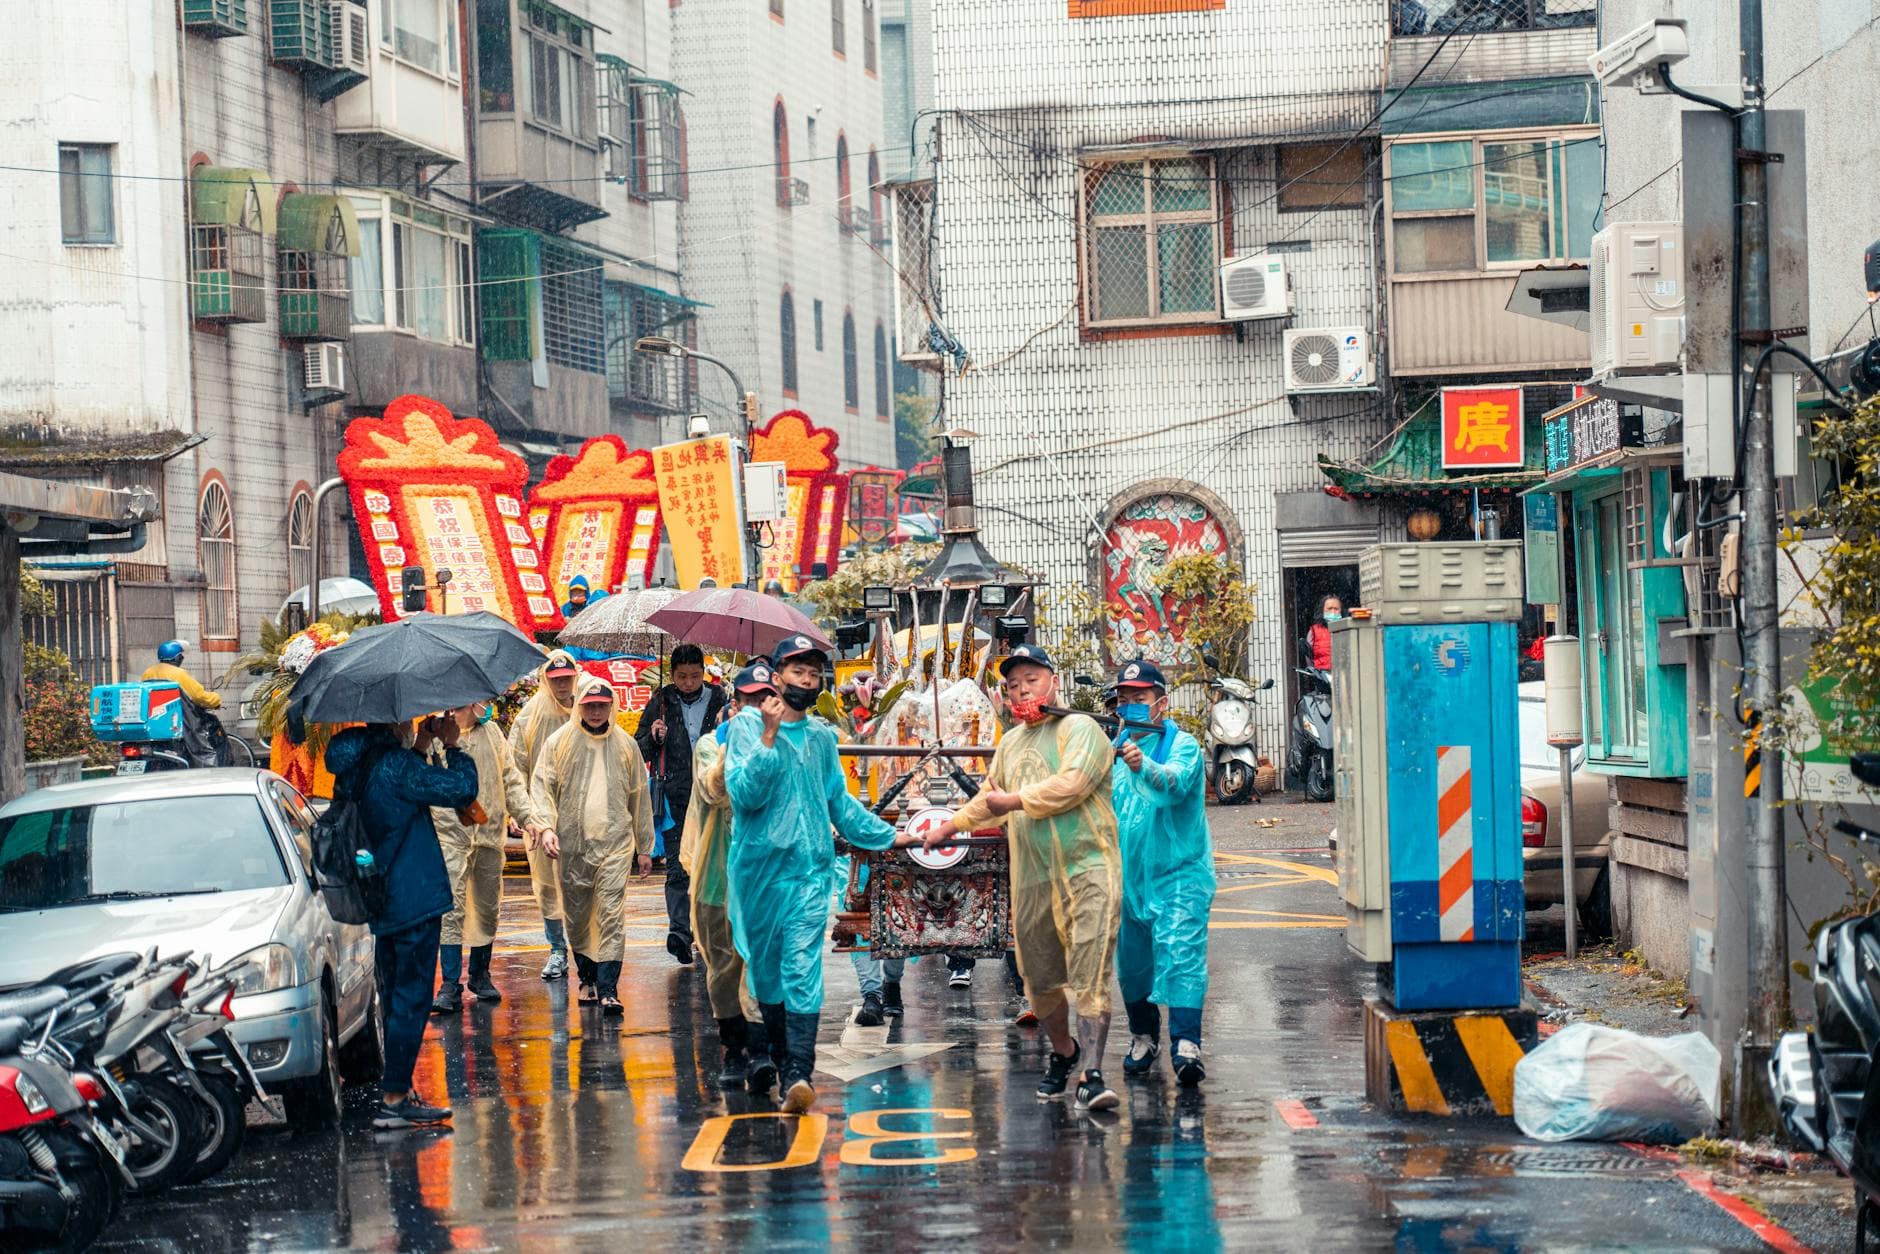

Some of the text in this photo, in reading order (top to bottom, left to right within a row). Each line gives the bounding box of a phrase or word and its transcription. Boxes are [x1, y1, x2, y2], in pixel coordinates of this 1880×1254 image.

[1454, 401, 1512, 454] 廣
[432, 500, 461, 533] 恭祝
[429, 537, 457, 593] 福德神
[448, 538, 478, 593] 保儀大夫
[466, 538, 495, 593] 三官大帝
[500, 496, 552, 615] 祈風調雨順
